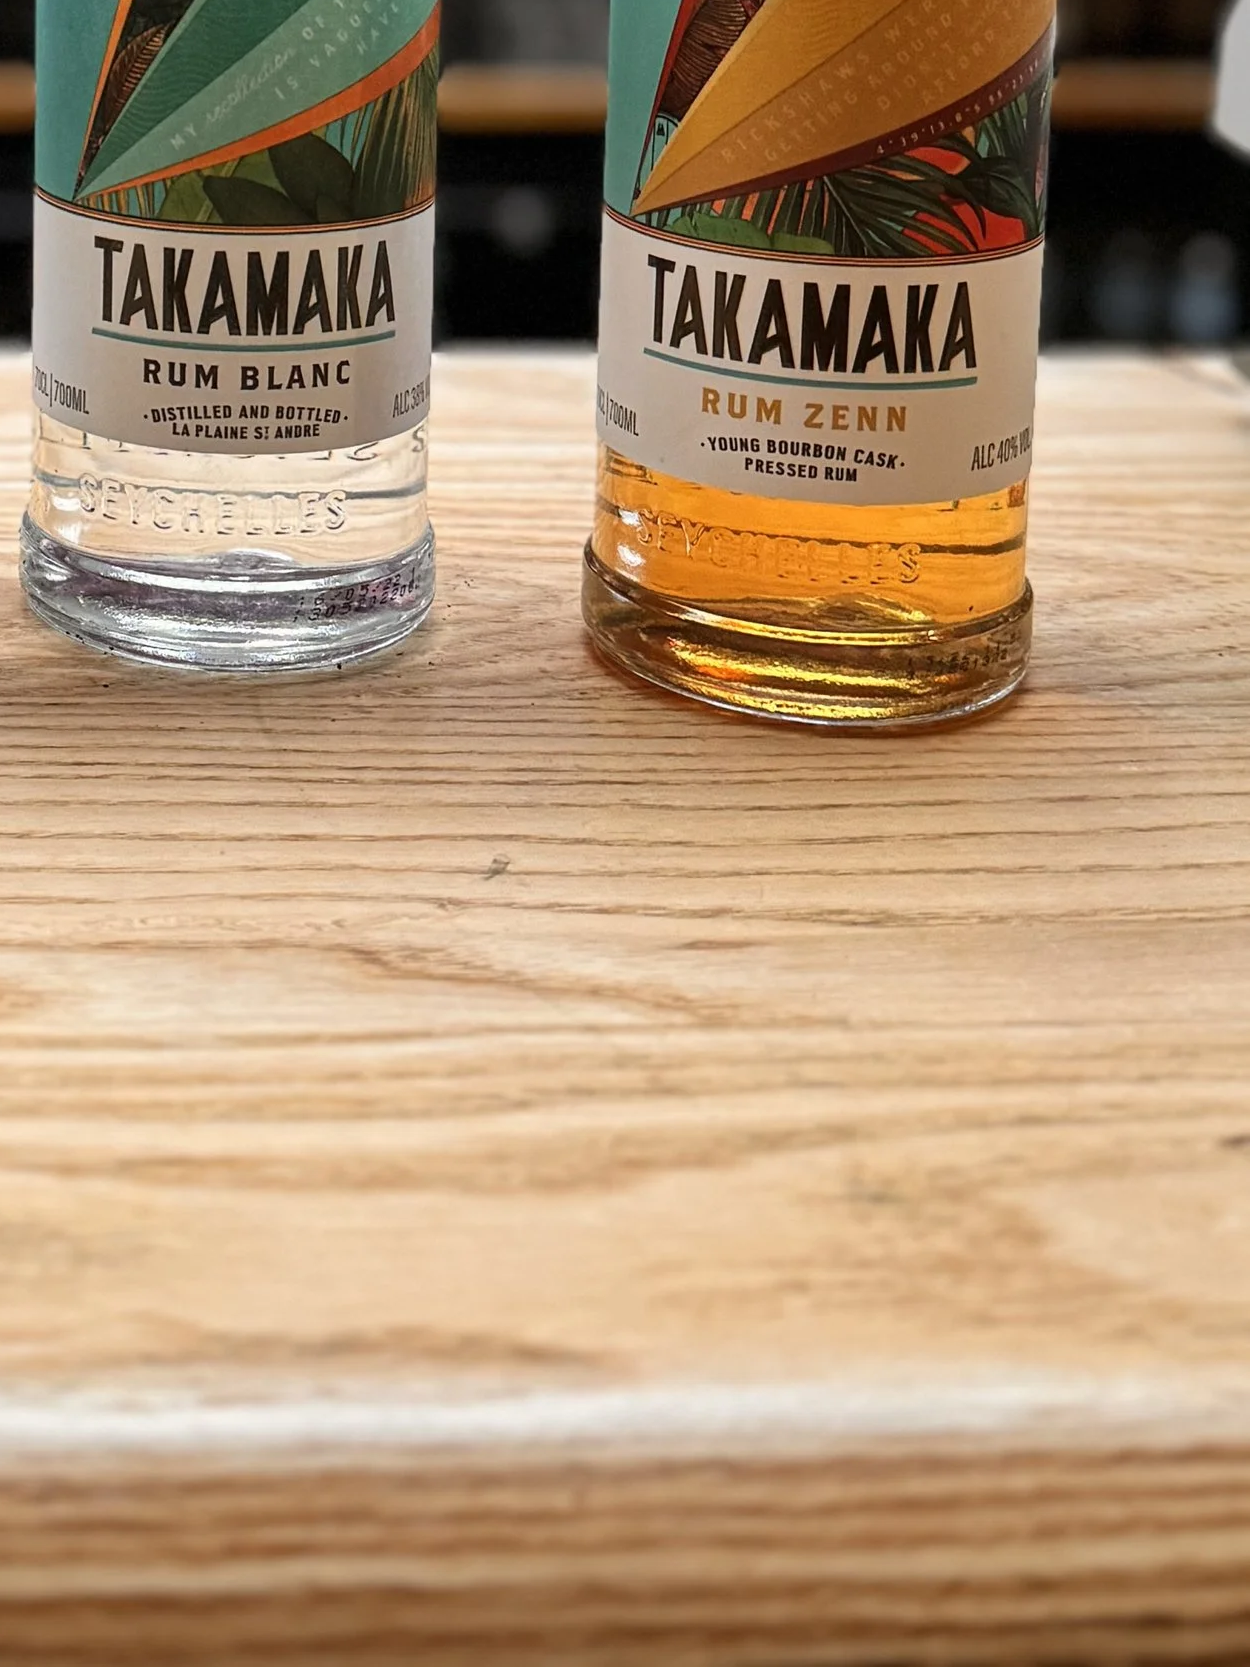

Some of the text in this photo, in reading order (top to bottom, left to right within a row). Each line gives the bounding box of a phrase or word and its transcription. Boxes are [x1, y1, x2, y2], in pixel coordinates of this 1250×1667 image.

[170, 124, 197, 150] MY
[302, 16, 325, 41] OF
[94, 235, 396, 336] TAKAMAKA
[648, 254, 977, 374] TAKAMAKA
[142, 357, 351, 391] RUM BLANC
[152, 404, 341, 424] DISTILLED AND BOTTLED
[393, 389, 410, 418] ALC
[701, 387, 908, 433] RUM ZENN
[172, 422, 190, 436] LA
[195, 424, 249, 440] PLAINE
[707, 436, 897, 470] YOUNG BOURBON CASK
[744, 458, 858, 482] PRESSED RUM
[971, 442, 996, 472] ALC
[997, 434, 1018, 464] 40%
[78, 472, 348, 535] SEYCHELLES
